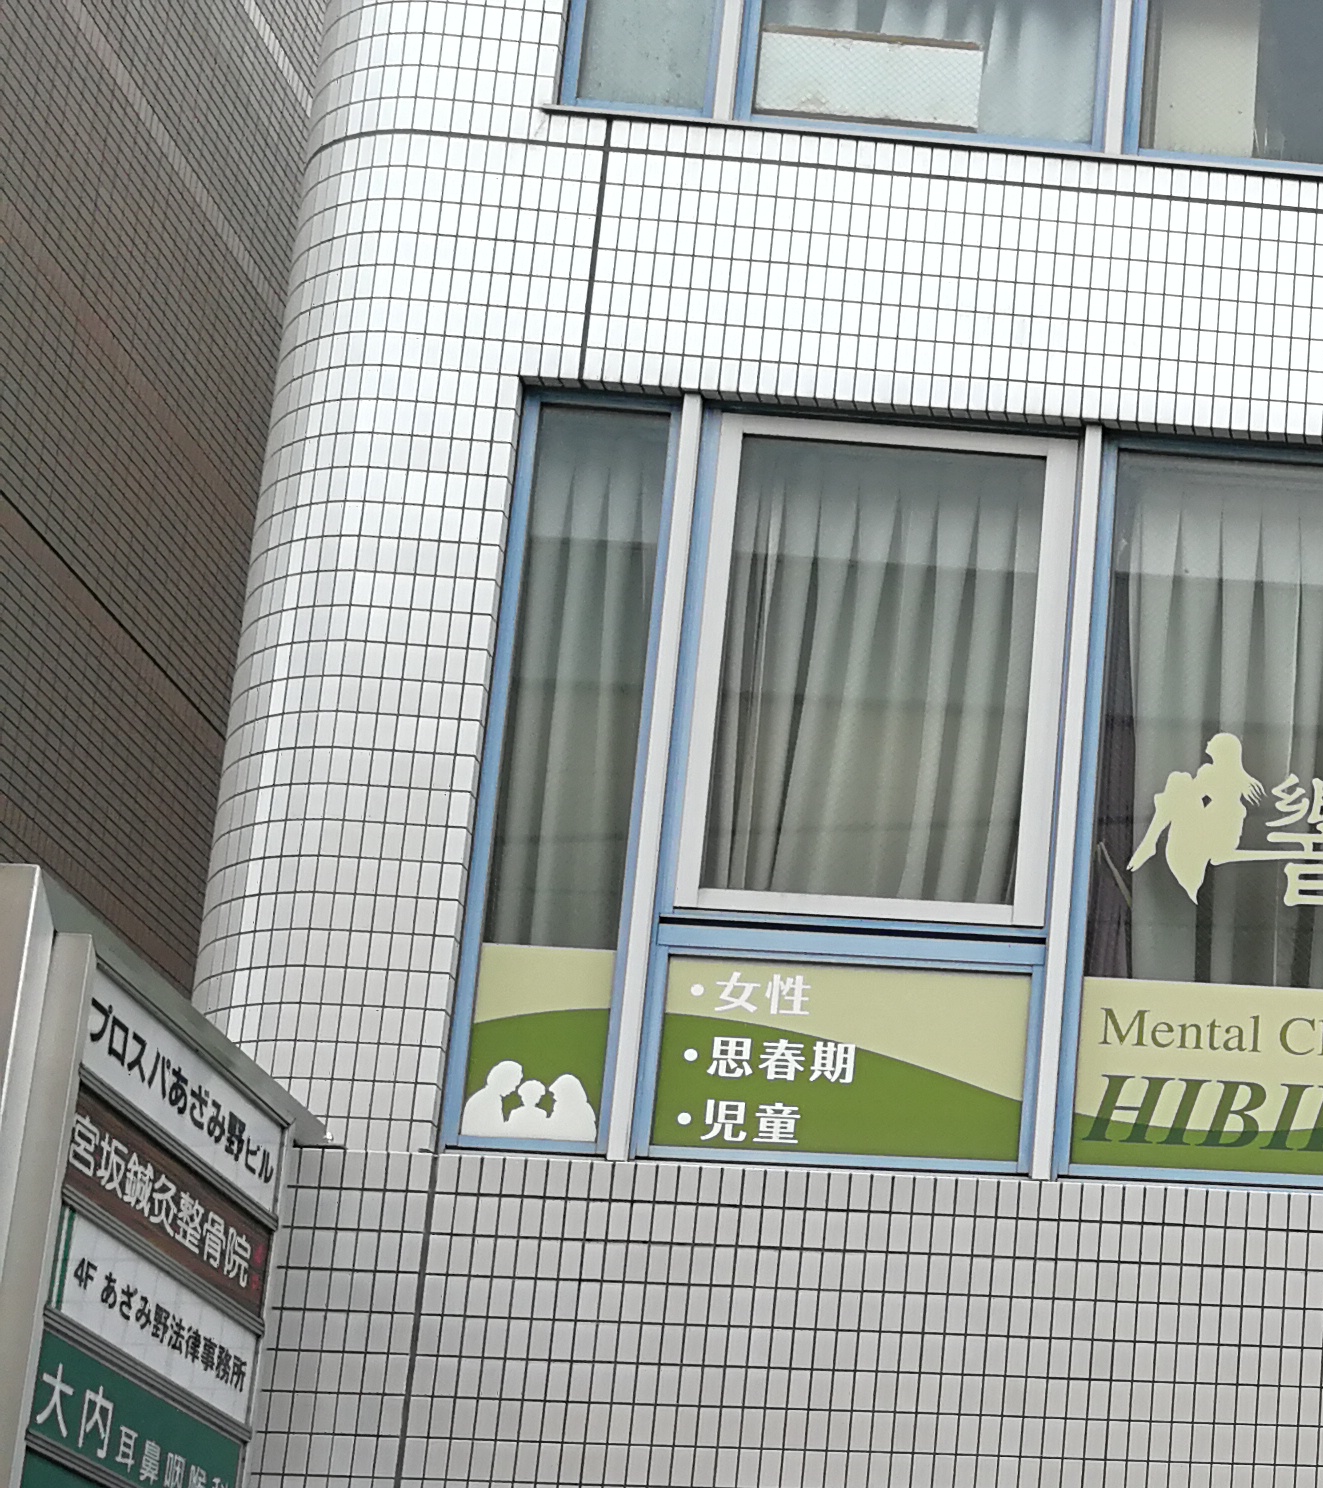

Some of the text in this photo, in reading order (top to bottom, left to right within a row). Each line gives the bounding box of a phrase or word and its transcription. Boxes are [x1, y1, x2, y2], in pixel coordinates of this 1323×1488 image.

[714, 971, 813, 1017] 女性
[1099, 1006, 1262, 1054] Mental
[706, 1036, 857, 1085] 思春期
[89, 997, 274, 1184] プロスパあざみ野ビル
[699, 1100, 802, 1146] 児童
[68, 1113, 252, 1289] 宮坂鍼灸整骨院
[73, 1257, 248, 1394] 4F あざみ野法律事務所
